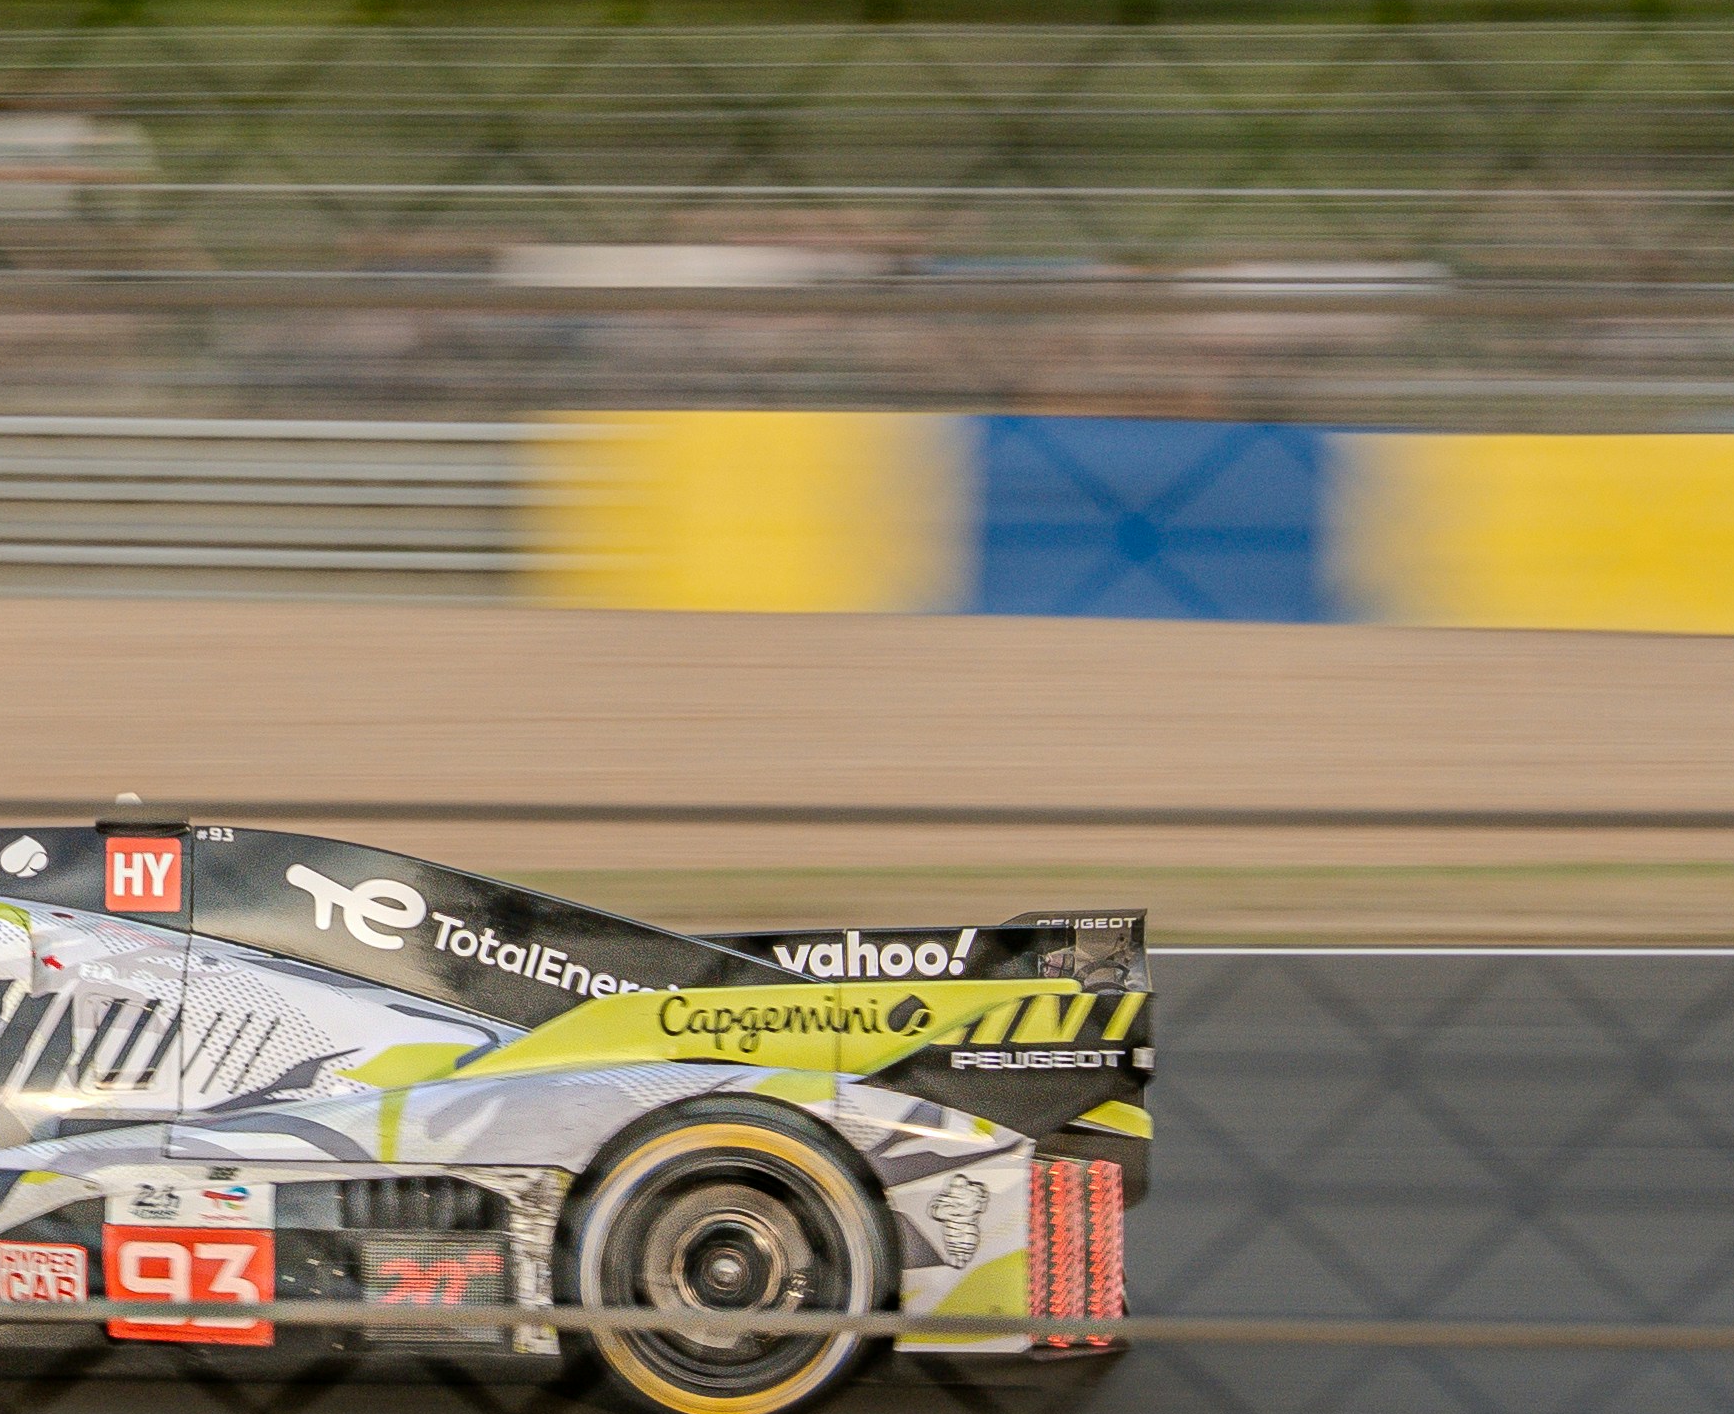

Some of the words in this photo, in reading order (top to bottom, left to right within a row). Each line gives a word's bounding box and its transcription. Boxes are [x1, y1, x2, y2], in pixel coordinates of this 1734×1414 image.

[196, 827, 234, 843] #93
[112, 852, 174, 897] HY
[432, 910, 680, 1000] TotalEner
[773, 927, 979, 978] yahoo!
[659, 994, 884, 1053] Capgemini
[949, 1049, 1127, 1069] PEUGEOT
[6, 1272, 80, 1304] CAR
[118, 1240, 261, 1330] 93
